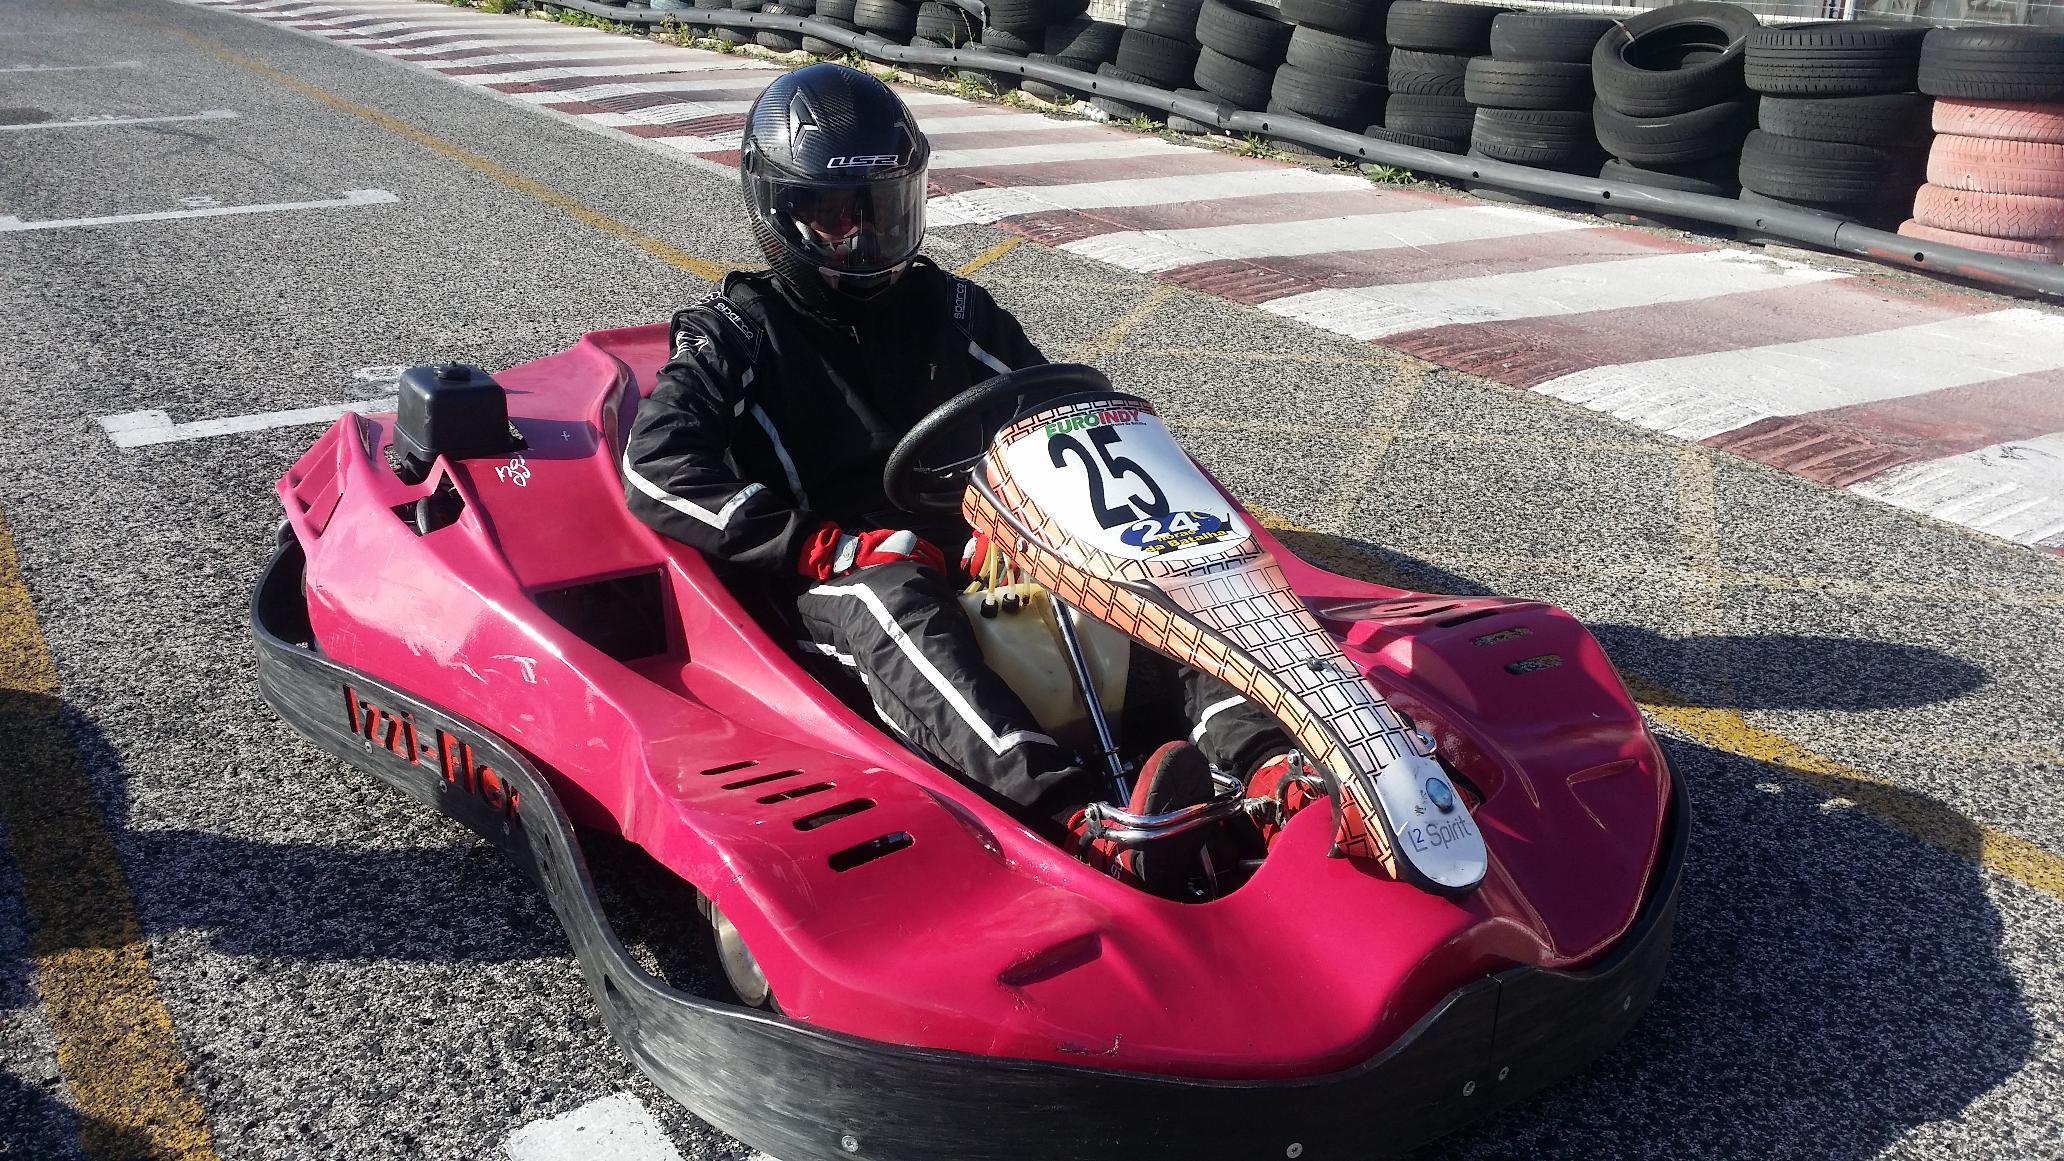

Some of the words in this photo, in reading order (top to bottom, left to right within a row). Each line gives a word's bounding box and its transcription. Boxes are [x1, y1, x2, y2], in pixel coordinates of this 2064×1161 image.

[827, 155, 898, 169] LS2
[953, 282, 966, 320] sparco
[715, 302, 754, 340] sparco
[1045, 410, 1139, 439] EUROINDY
[1048, 425, 1169, 530] 25
[1132, 512, 1201, 543] 24
[1168, 530, 1228, 547] Batalha
[1426, 816, 1472, 849] Spirit
